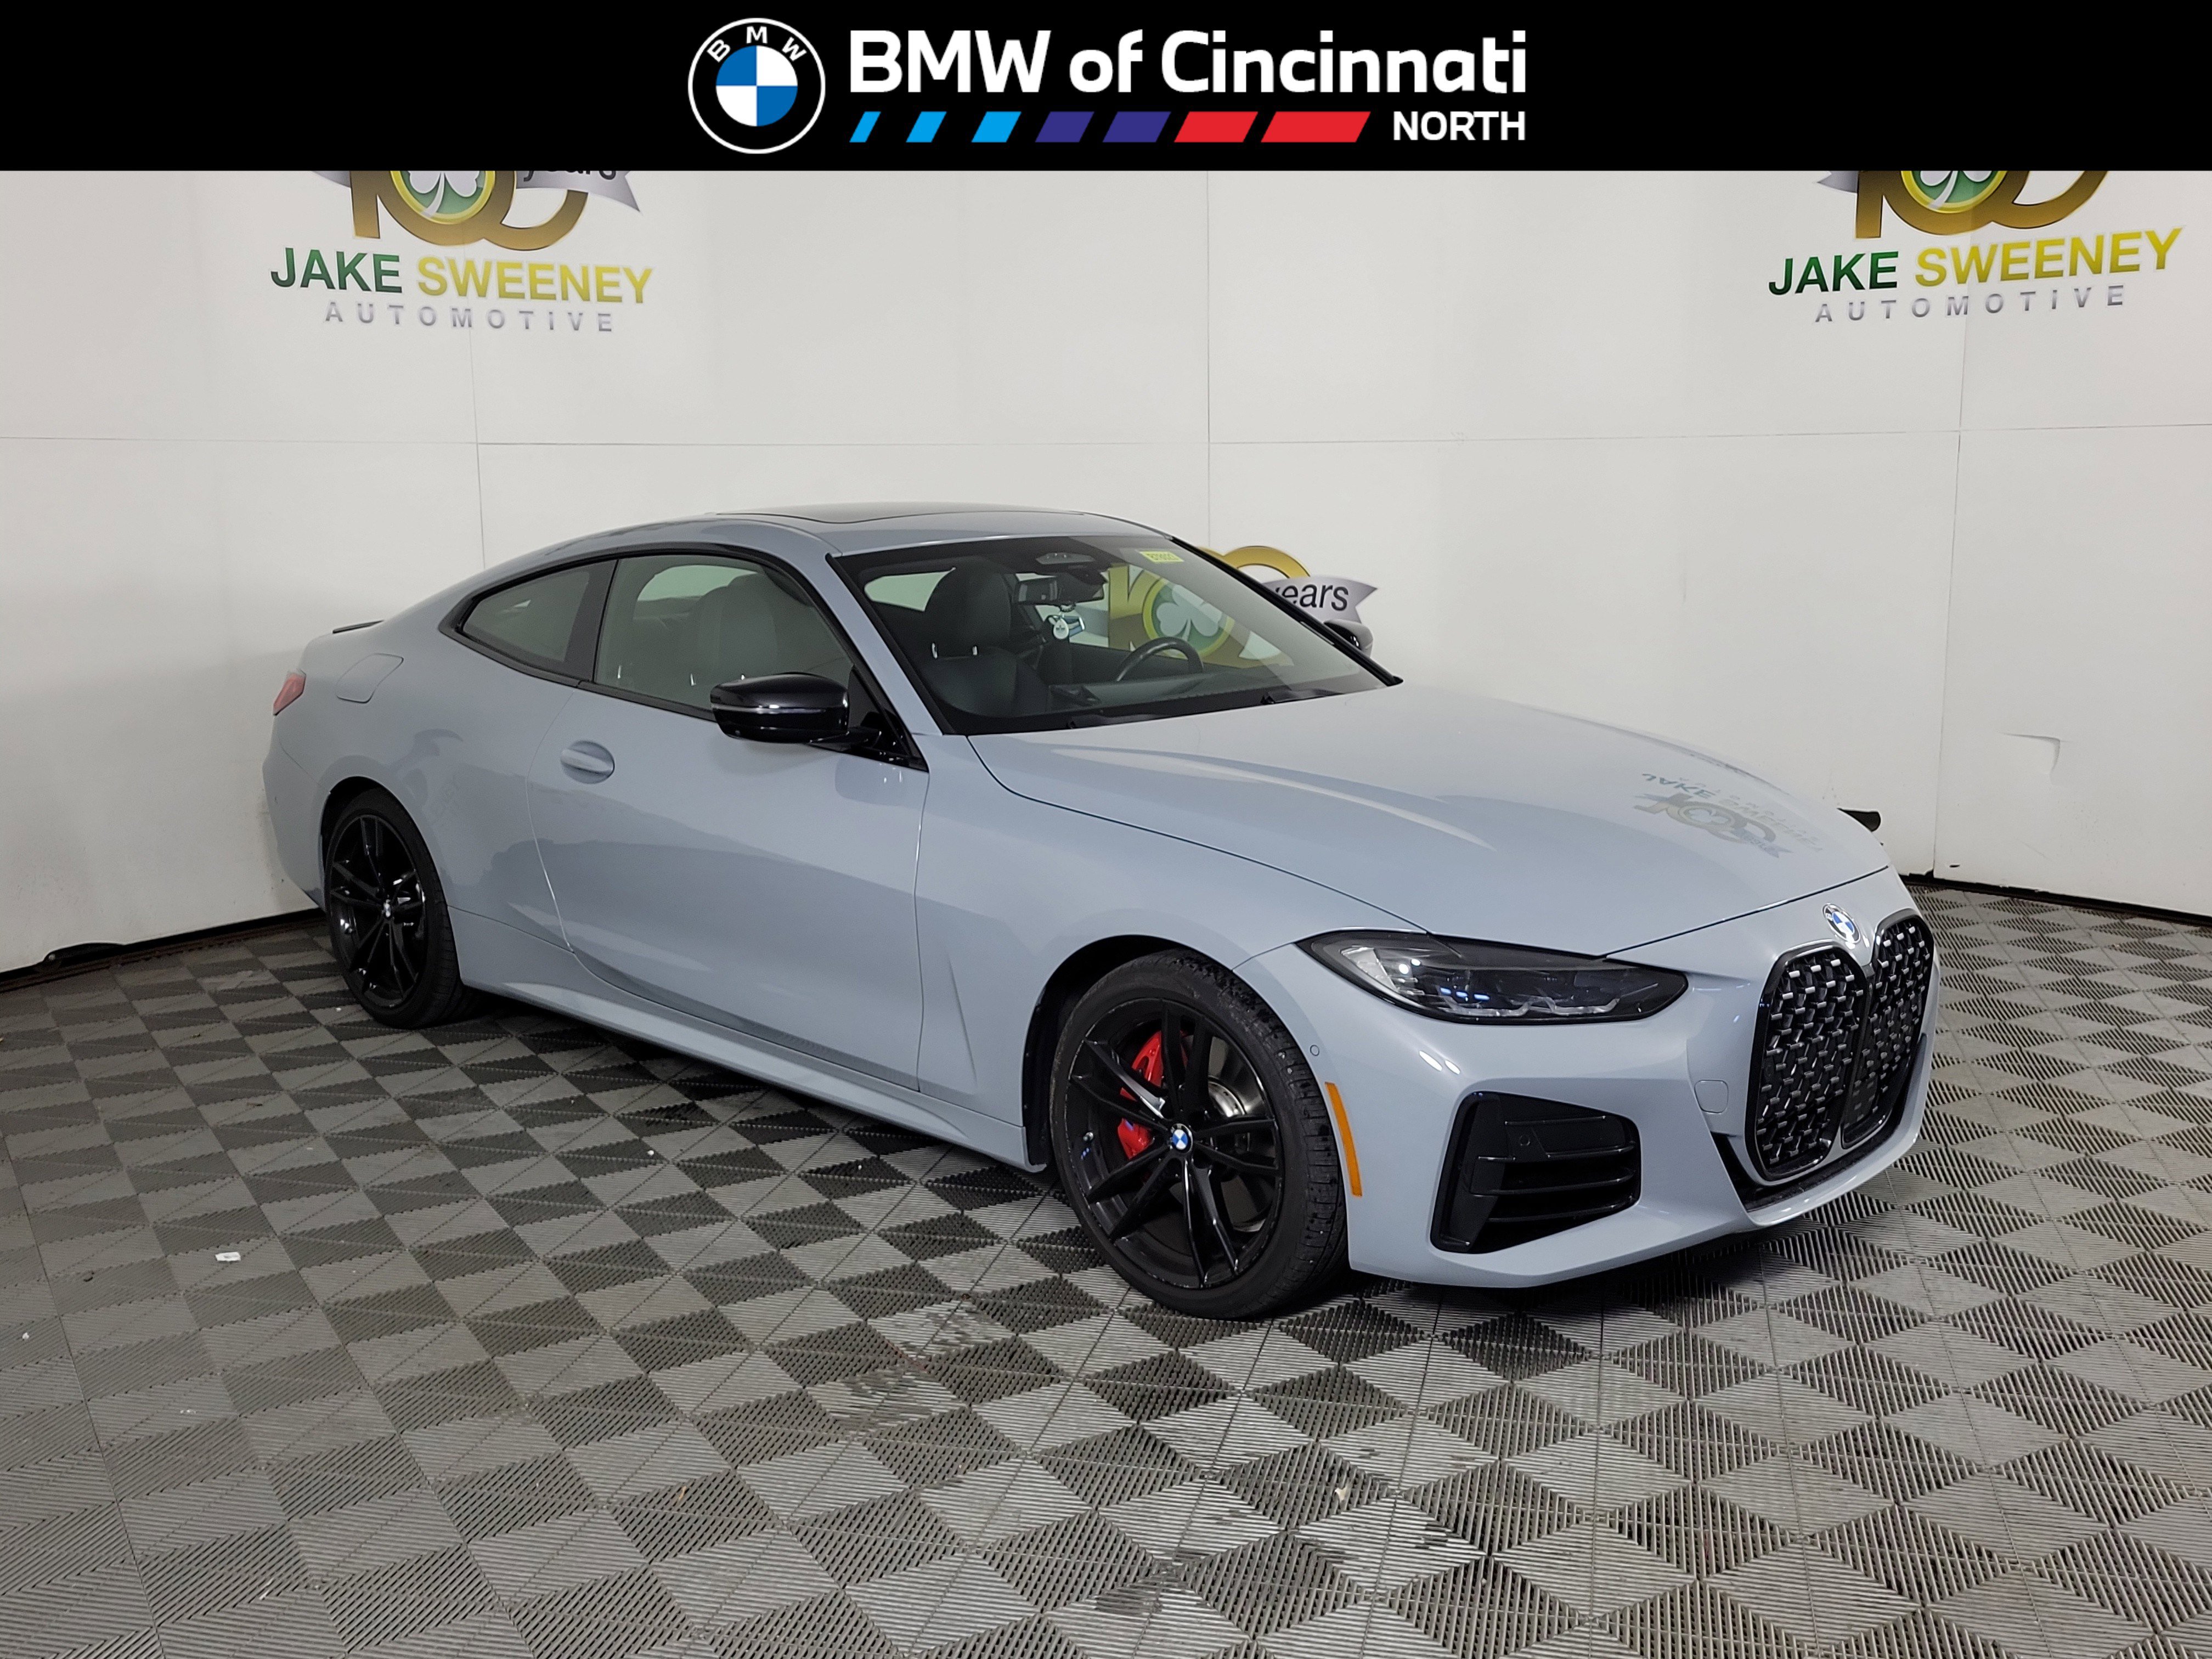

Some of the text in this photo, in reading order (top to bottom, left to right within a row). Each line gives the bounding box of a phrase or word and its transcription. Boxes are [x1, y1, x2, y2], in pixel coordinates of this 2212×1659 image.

[270, 247, 653, 303] JAKE SWEENEY
[1768, 228, 2183, 296] JAKE SWEENEY
[325, 302, 613, 332] AUTOMOTIVE
[1815, 285, 2125, 323] AUTOMOTIVE
[1275, 584, 1349, 612] ears
